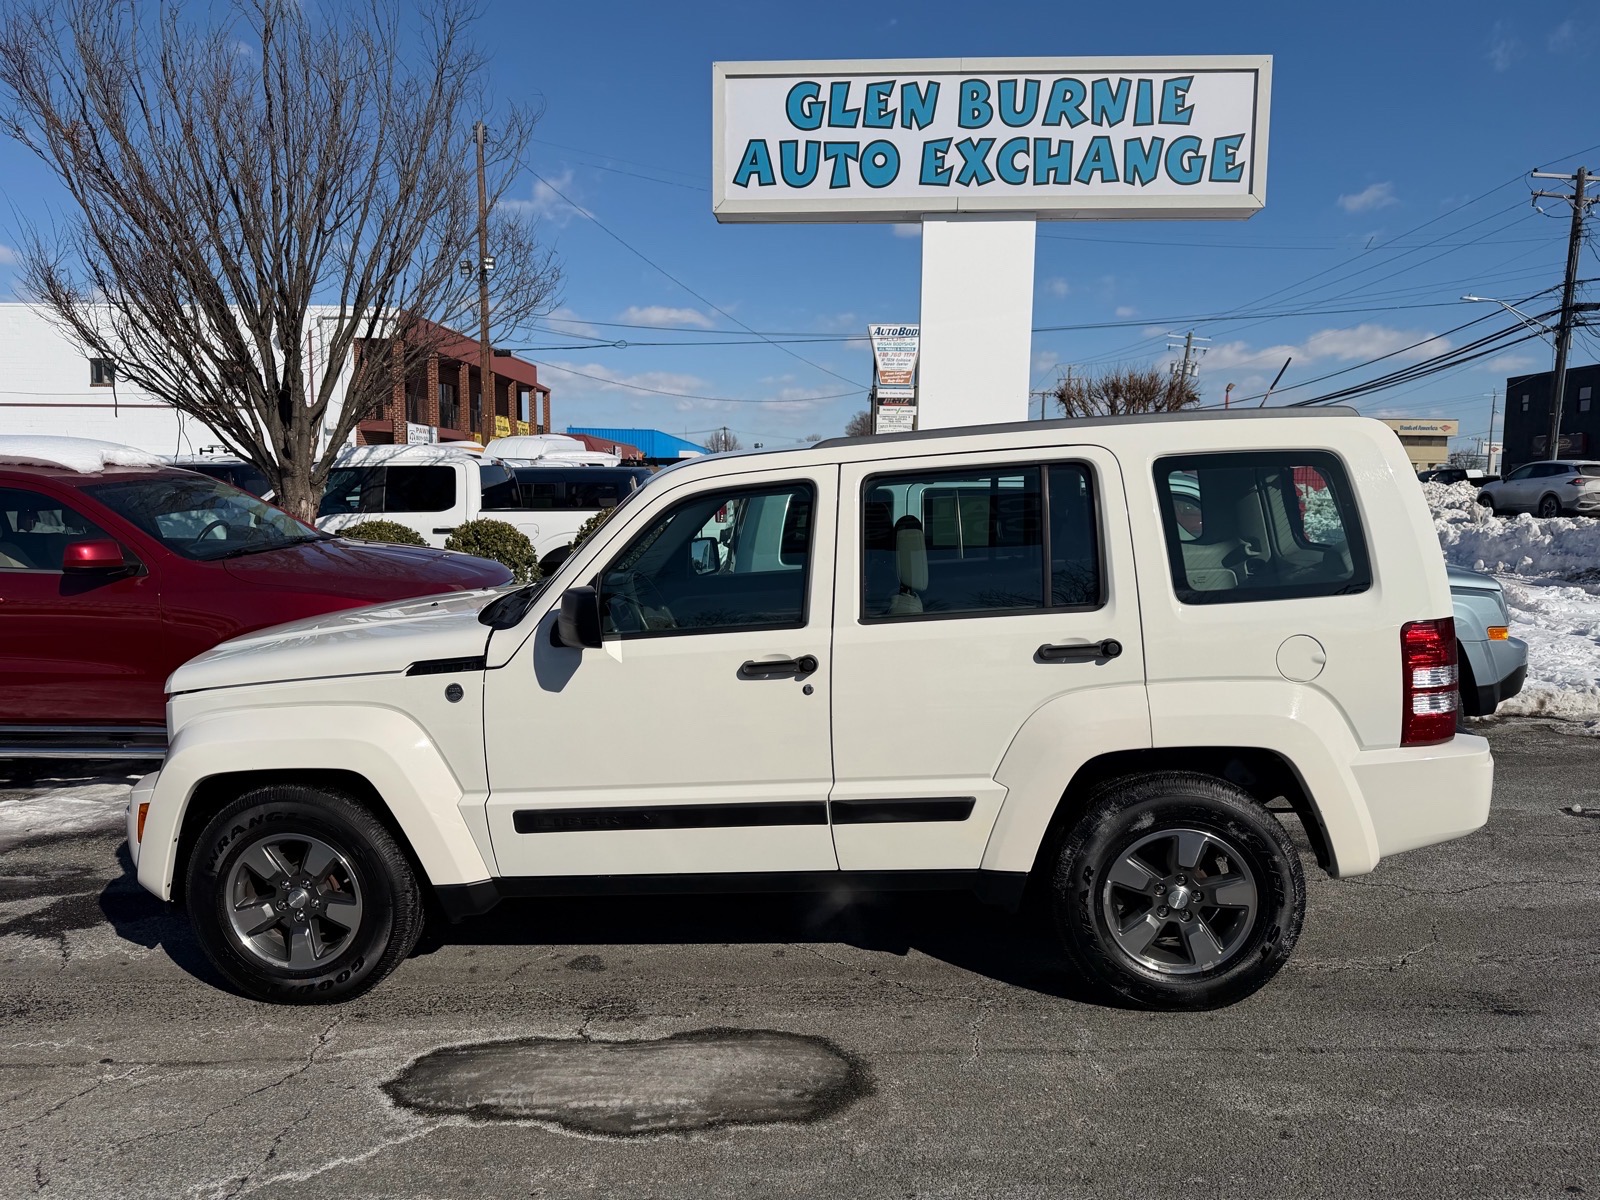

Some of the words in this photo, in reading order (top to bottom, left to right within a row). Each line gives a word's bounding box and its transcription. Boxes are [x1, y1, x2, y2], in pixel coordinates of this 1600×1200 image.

[785, 80, 941, 131] GLEN
[957, 75, 1195, 129] BURNIE
[732, 138, 901, 189] AUTO
[919, 133, 1246, 188] EXCHANGE
